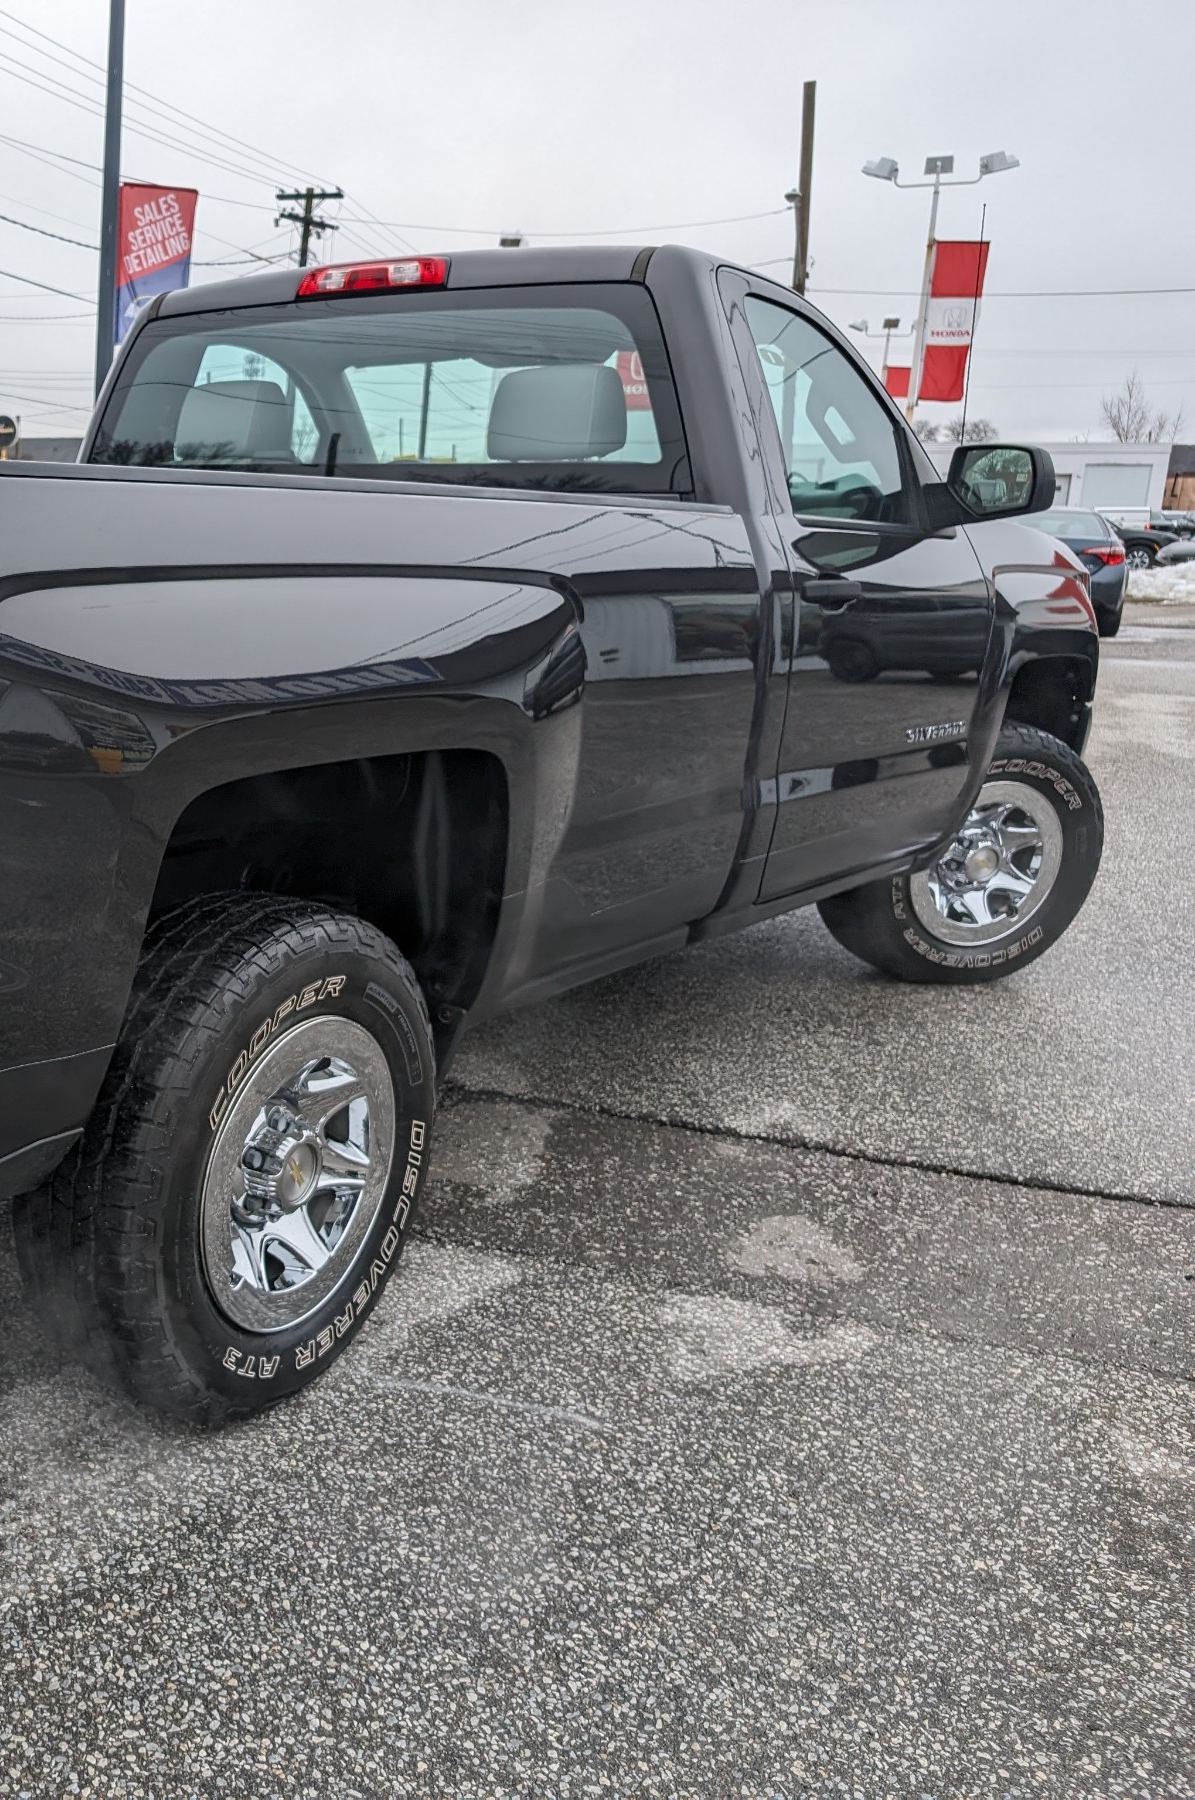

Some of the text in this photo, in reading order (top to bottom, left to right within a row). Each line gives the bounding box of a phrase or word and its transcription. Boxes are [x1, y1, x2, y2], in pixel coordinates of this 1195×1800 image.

[127, 213, 186, 251] SERVICE
[133, 194, 179, 227] SALES
[123, 232, 191, 275] DETAILING
[906, 720, 966, 743] SILVERADO
[987, 758, 1083, 810] COOPER
[903, 925, 1044, 968] DISCOVERER
[209, 974, 346, 1131] COOPER
[222, 1119, 426, 1380] DISCOVERER AT3
